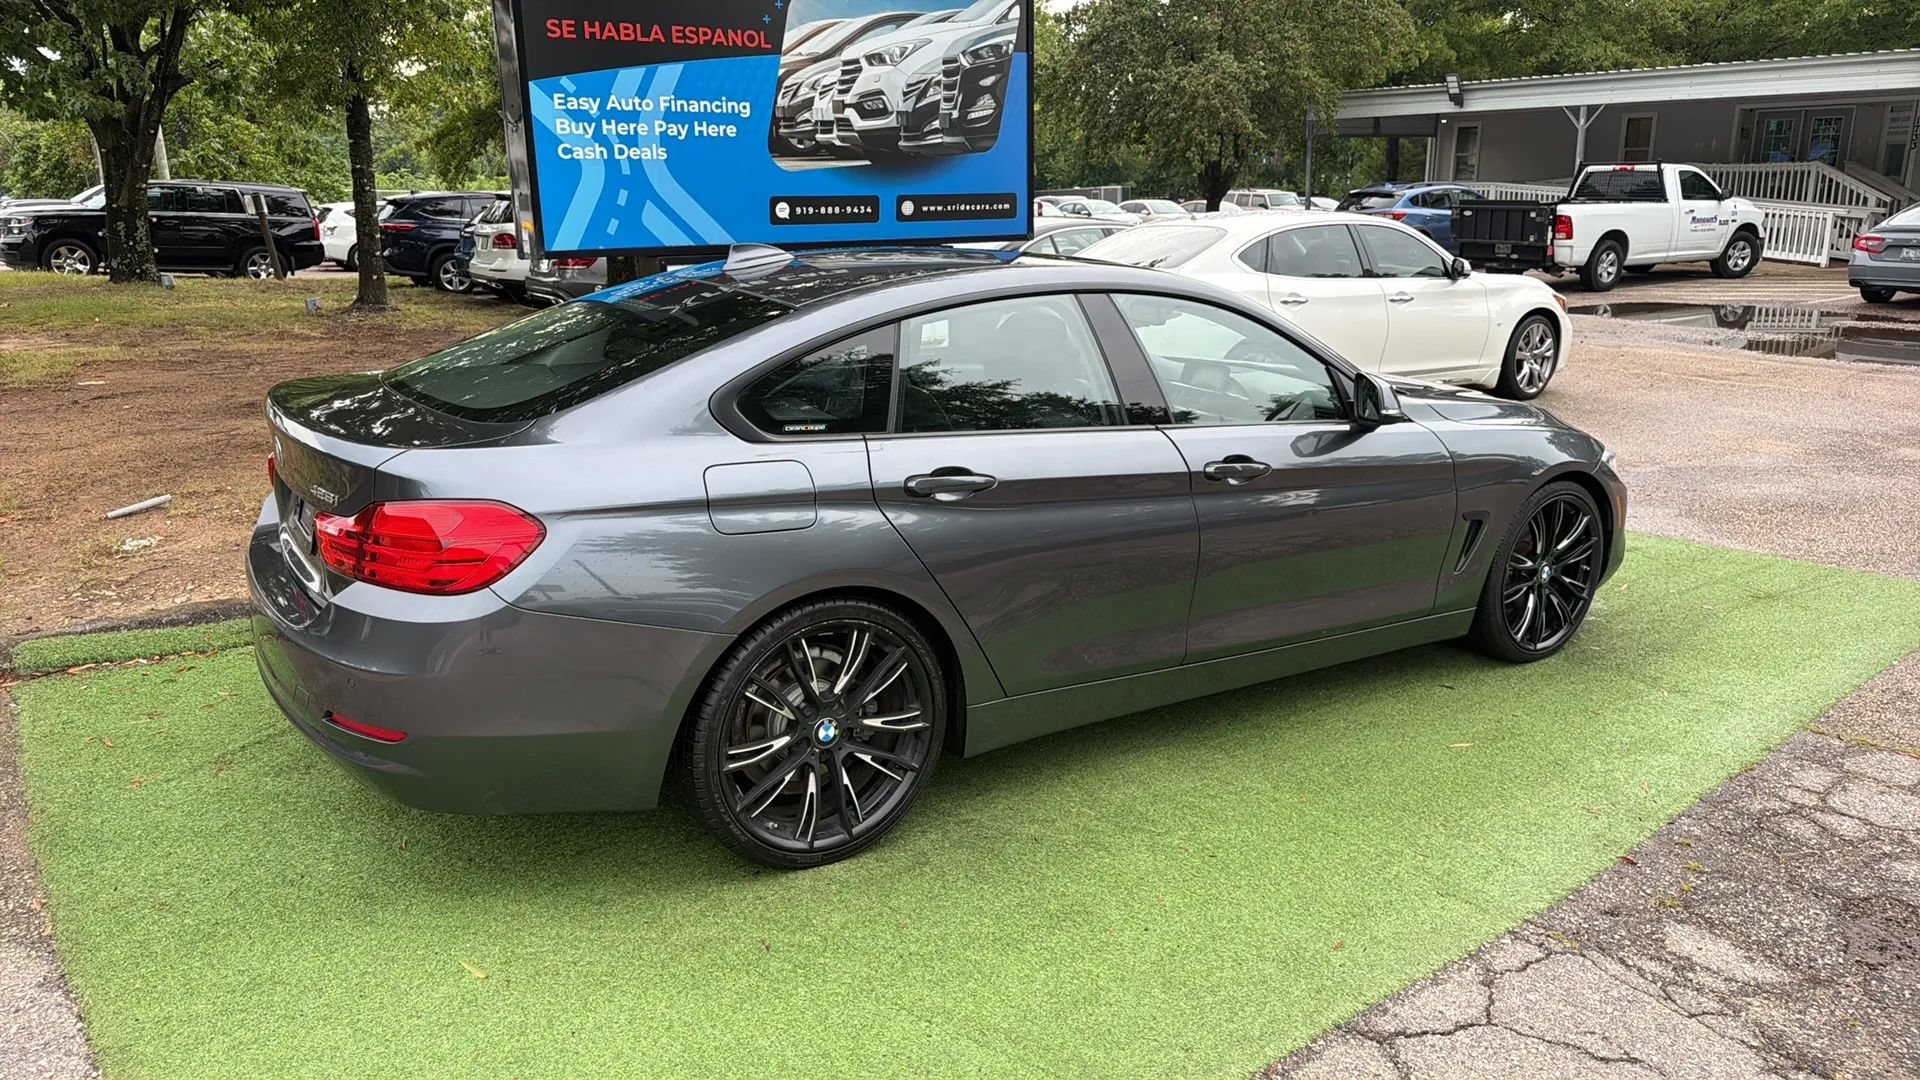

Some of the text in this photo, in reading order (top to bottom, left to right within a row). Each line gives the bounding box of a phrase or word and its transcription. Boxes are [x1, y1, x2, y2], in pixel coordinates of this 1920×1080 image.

[546, 19, 772, 49] SE HABLA ESPANOL
[553, 93, 751, 118] Easy Auto Financing
[555, 118, 737, 140] Buy Here Pay Here
[557, 143, 668, 160] Cash Deals
[795, 206, 873, 215] 919-888-9434
